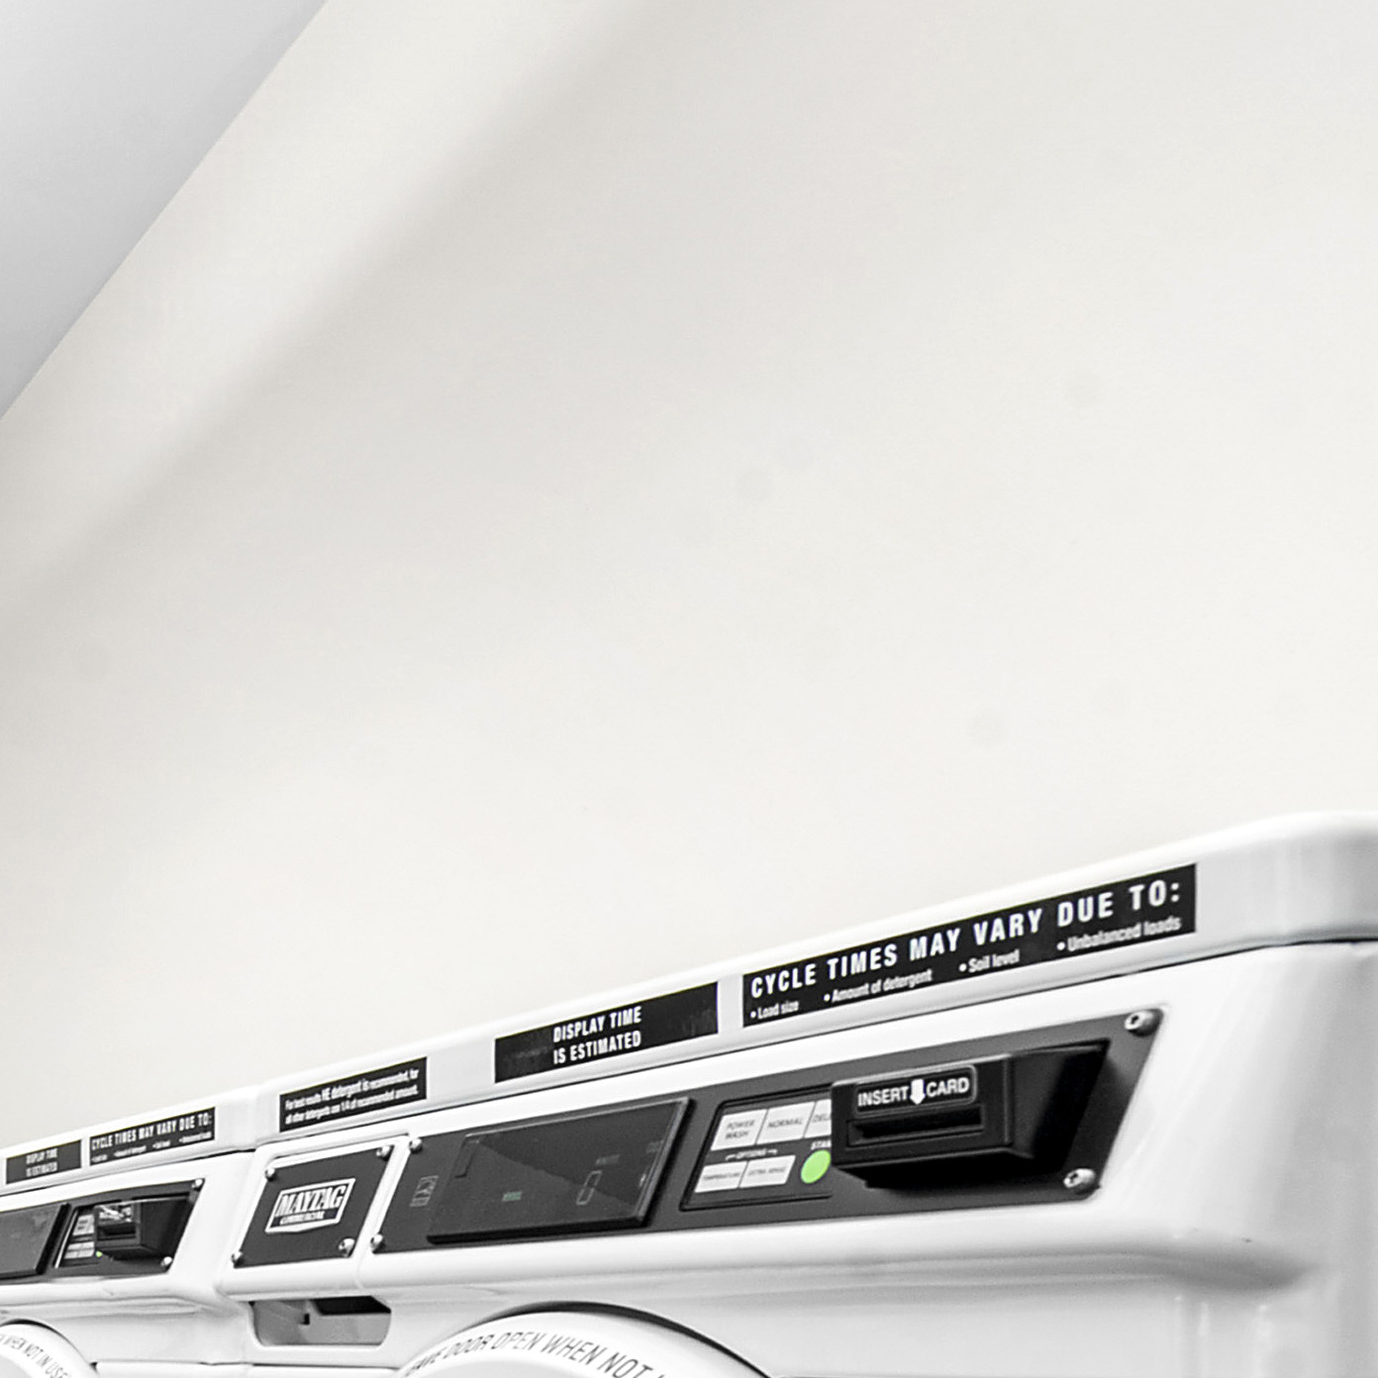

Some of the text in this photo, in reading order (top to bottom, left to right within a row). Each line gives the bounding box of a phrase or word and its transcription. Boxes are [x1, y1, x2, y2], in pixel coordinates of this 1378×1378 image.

[751, 879, 1180, 998] CYCLE TIMES MAY VARY DUE TO:
[757, 915, 1181, 1019] Load size Amount of detergent Soil level Unbalanced loads
[553, 1006, 642, 1043] DISPLAY TIME
[553, 1030, 641, 1064] IS ESTIMATED
[857, 1077, 970, 1108] INSERT CARD
[92, 1135, 113, 1150] CYCLE
[179, 1116, 195, 1131] DUE
[767, 1118, 804, 1129] NORMAL
[275, 1185, 347, 1217] MAYTAG
[490, 1331, 546, 1351] OPEN
[540, 1334, 607, 1366] WHEN
